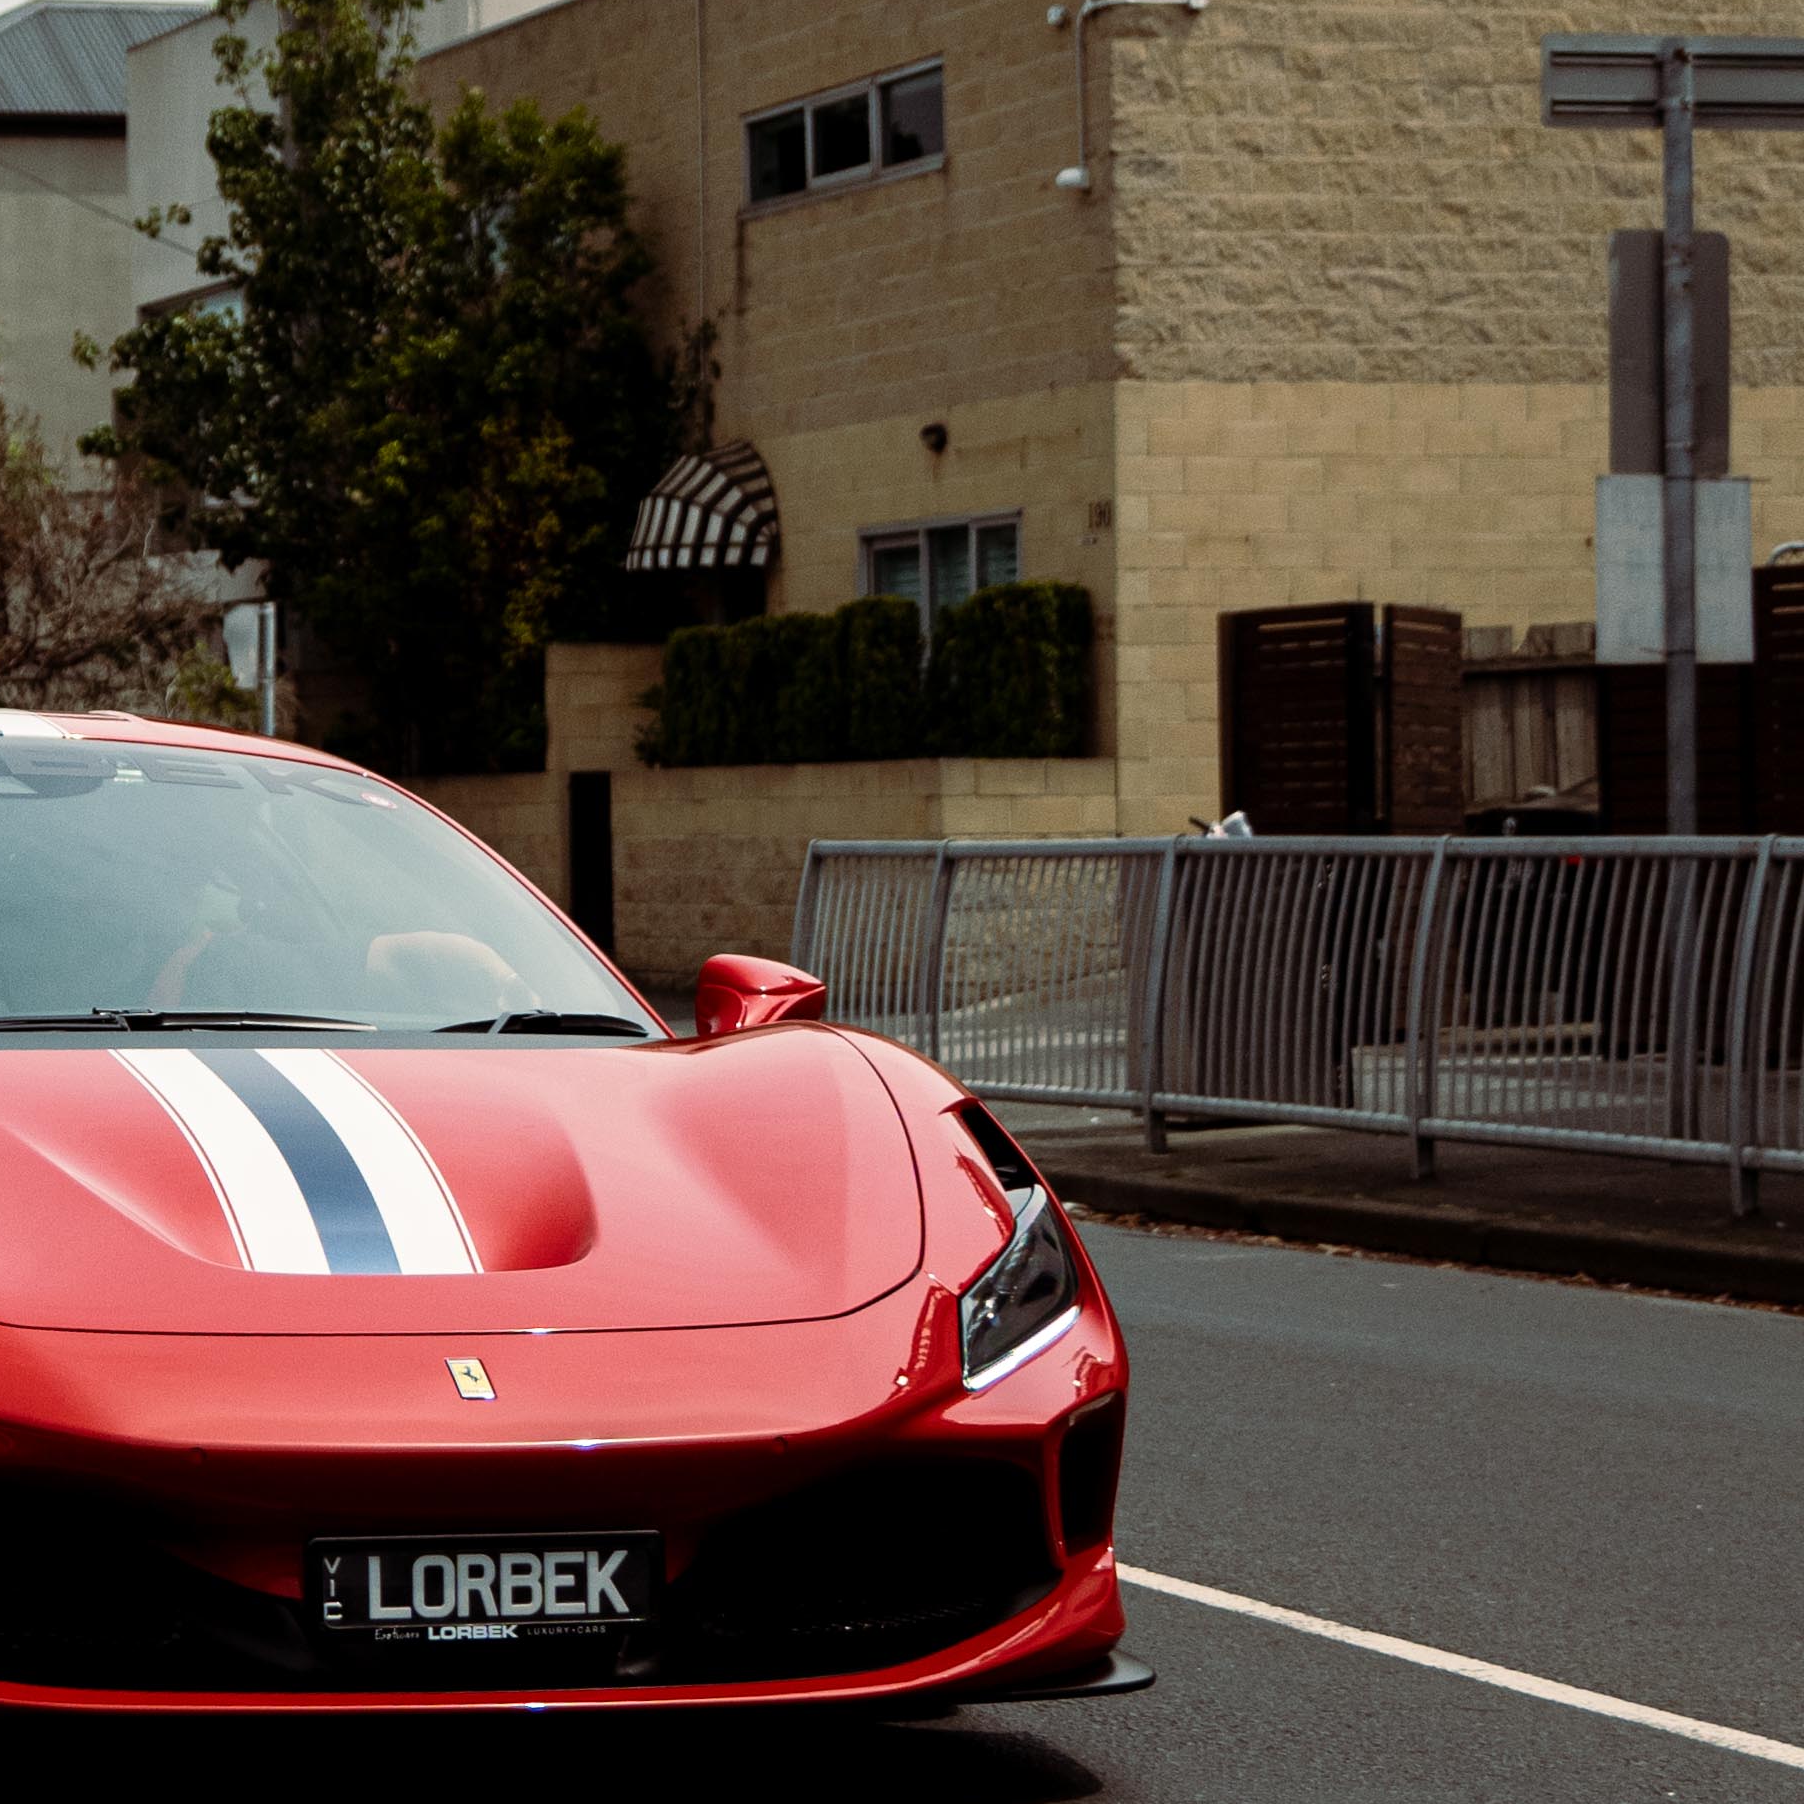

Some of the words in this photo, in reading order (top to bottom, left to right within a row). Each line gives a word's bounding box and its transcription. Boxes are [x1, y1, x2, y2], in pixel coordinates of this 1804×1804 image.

[323, 1556, 343, 1620] VIC
[368, 1550, 630, 1620] LORBEK
[427, 1624, 519, 1640] LORBEK
